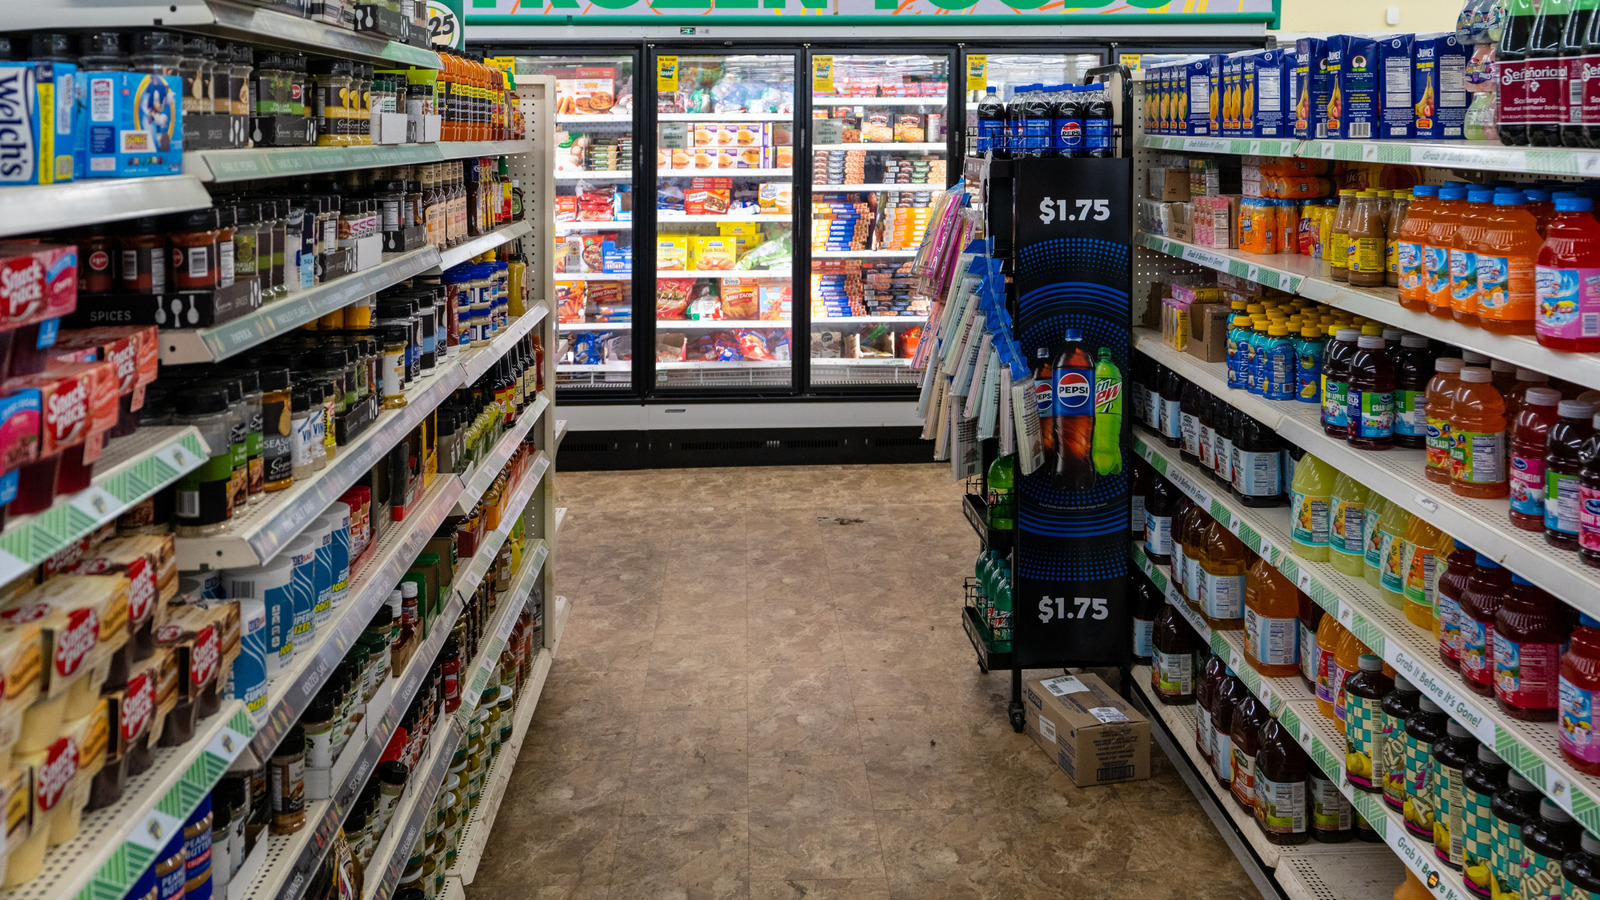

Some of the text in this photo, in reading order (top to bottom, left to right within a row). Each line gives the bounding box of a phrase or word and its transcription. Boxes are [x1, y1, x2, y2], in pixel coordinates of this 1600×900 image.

[1419, 48, 1434, 58] JUMEX
[0, 72, 28, 178] Welch's
[1039, 197, 1110, 224] $1.75
[1, 259, 43, 297] Snack
[9, 281, 42, 315] pack
[90, 310, 131, 321] SPICES
[48, 384, 87, 424] Snack
[1059, 386, 1088, 394] PEPSI
[56, 403, 87, 440] pack
[1450, 448, 1464, 461] PLASH
[294, 621, 311, 635] IZED
[1038, 596, 1109, 623] $1.75
[58, 610, 97, 648] Snack
[193, 626, 218, 662] Snack
[58, 630, 97, 674] pack
[193, 645, 218, 682] pack
[122, 680, 152, 713] Snack
[1396, 652, 1482, 727] Grab It Before It's Gone!
[122, 698, 153, 738] pack
[38, 744, 76, 782] Snack
[38, 762, 76, 806] pack
[1398, 836, 1415, 860] Grab
[1415, 855, 1423, 867] It
[1421, 862, 1446, 894] Bere
